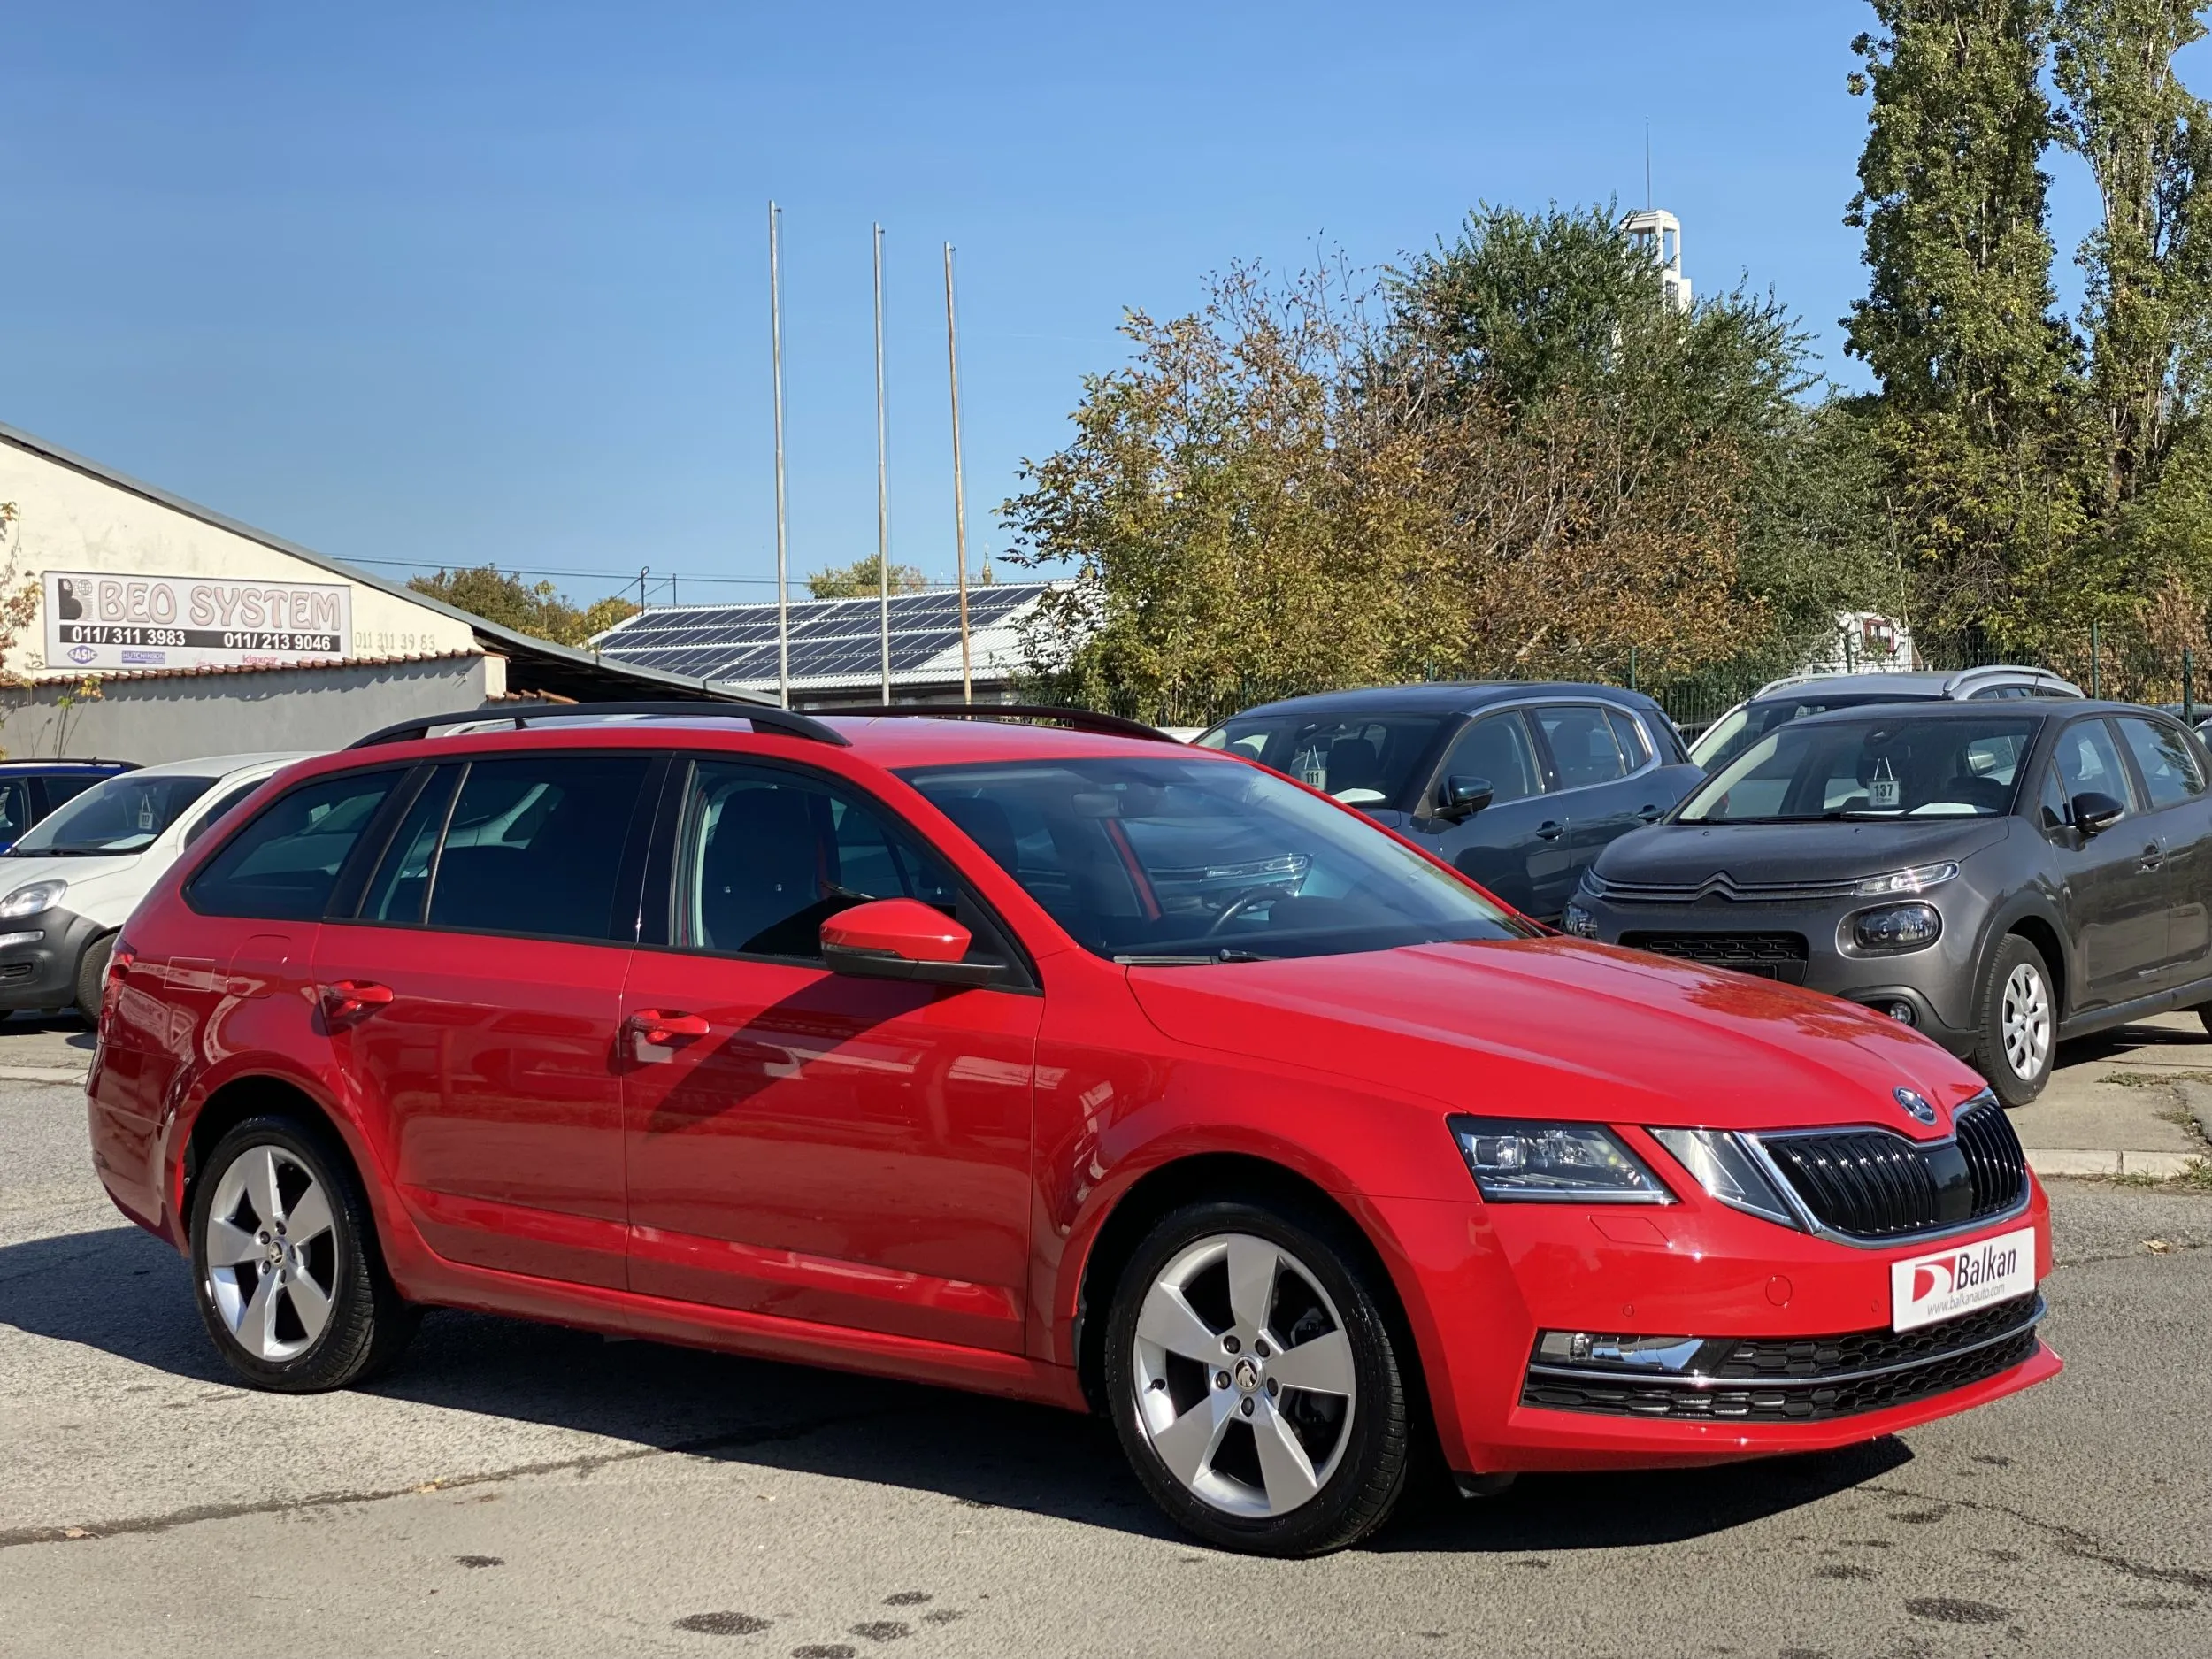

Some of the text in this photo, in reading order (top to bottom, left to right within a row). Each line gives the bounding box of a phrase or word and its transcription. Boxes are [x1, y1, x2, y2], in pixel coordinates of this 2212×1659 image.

[98, 580, 341, 631] BEO SYSTEM
[72, 626, 186, 646] 011/ 311 3983
[223, 632, 331, 651] 011/ 213 9046
[69, 649, 96, 661] SASIC
[1305, 772, 1319, 784] 111
[1874, 784, 1893, 798] 137
[1957, 1245, 2016, 1290] Balkan
[1926, 1283, 2005, 1317] www.balkanauto.com
